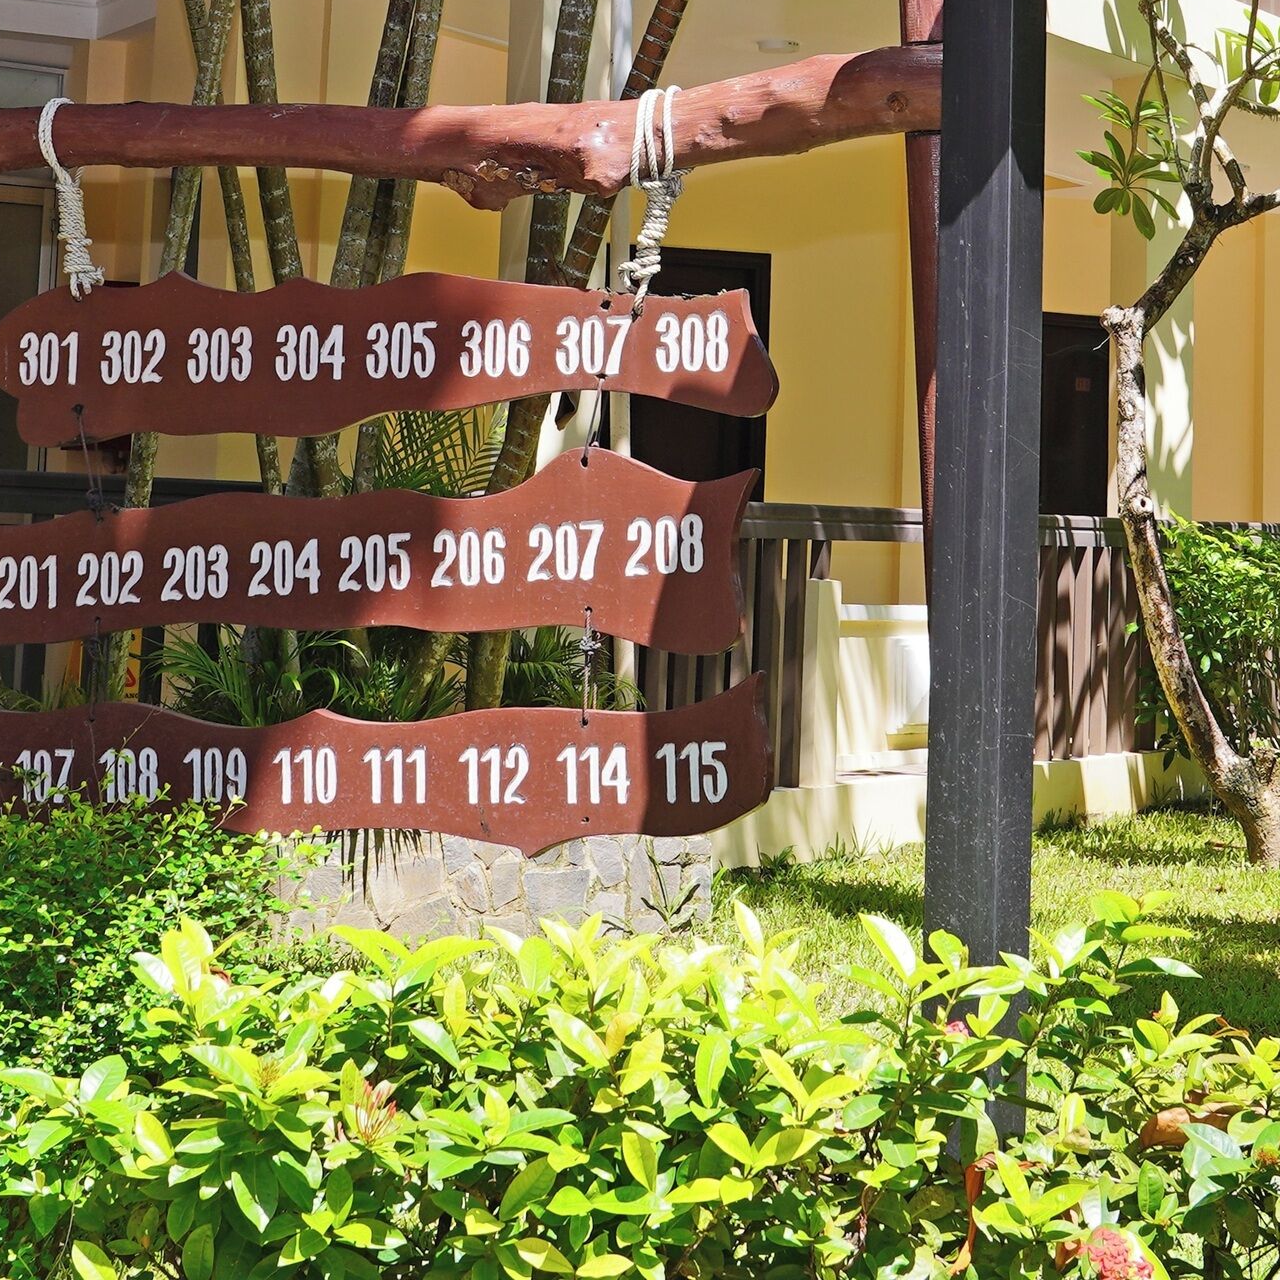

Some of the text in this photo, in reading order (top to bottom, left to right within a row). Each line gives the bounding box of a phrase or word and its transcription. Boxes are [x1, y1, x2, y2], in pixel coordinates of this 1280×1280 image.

[19, 309, 730, 385] 301 302 303 304 305 306 307 308
[76, 551, 143, 607] 202
[161, 544, 228, 601] 203
[248, 538, 321, 597] 204
[338, 532, 411, 592] 205
[431, 527, 506, 588] 206
[527, 520, 604, 582] 207
[625, 513, 703, 578] 208
[15, 741, 727, 805] 107 108 109 110 111 112 114 115
